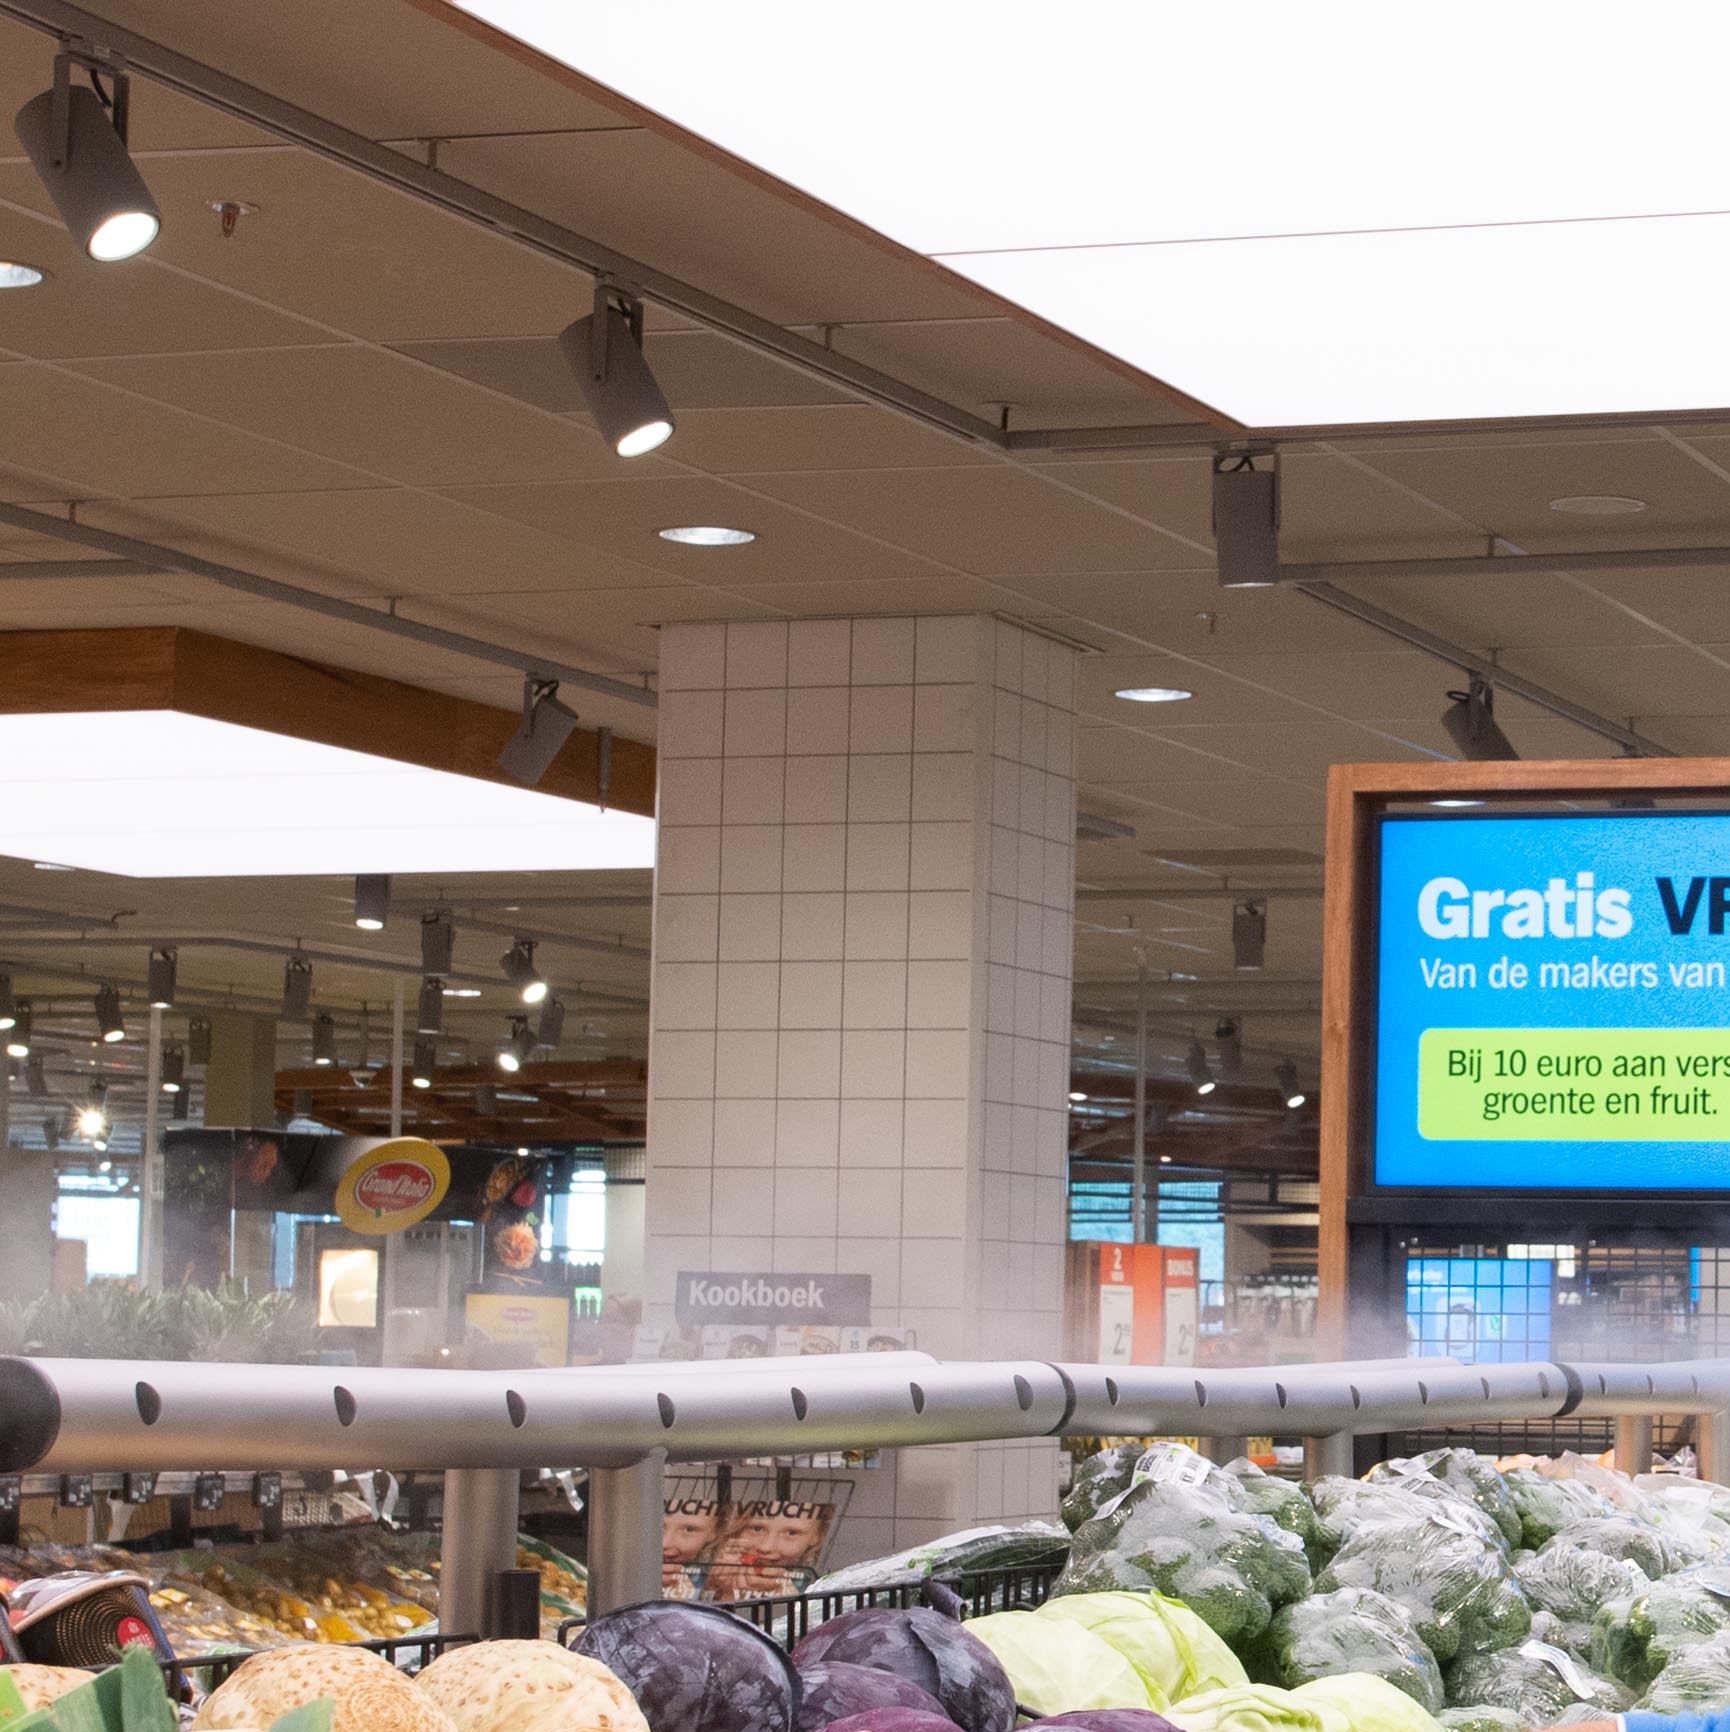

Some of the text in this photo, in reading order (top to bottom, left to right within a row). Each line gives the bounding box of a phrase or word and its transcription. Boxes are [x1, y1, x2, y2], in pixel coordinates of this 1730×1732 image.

[1417, 871, 1634, 940] Gratis
[1420, 957, 1477, 989] Van
[1488, 955, 1529, 989] de
[1540, 954, 1659, 989] makers
[1669, 960, 1725, 988] van
[1447, 1048, 1483, 1084] Bij
[1494, 1049, 1527, 1077] 10
[1536, 1054, 1602, 1078] euro
[1612, 1053, 1667, 1078] aan
[1482, 1085, 1719, 1121] groente en fruit.
[688, 1279, 826, 1310] Kookboek
